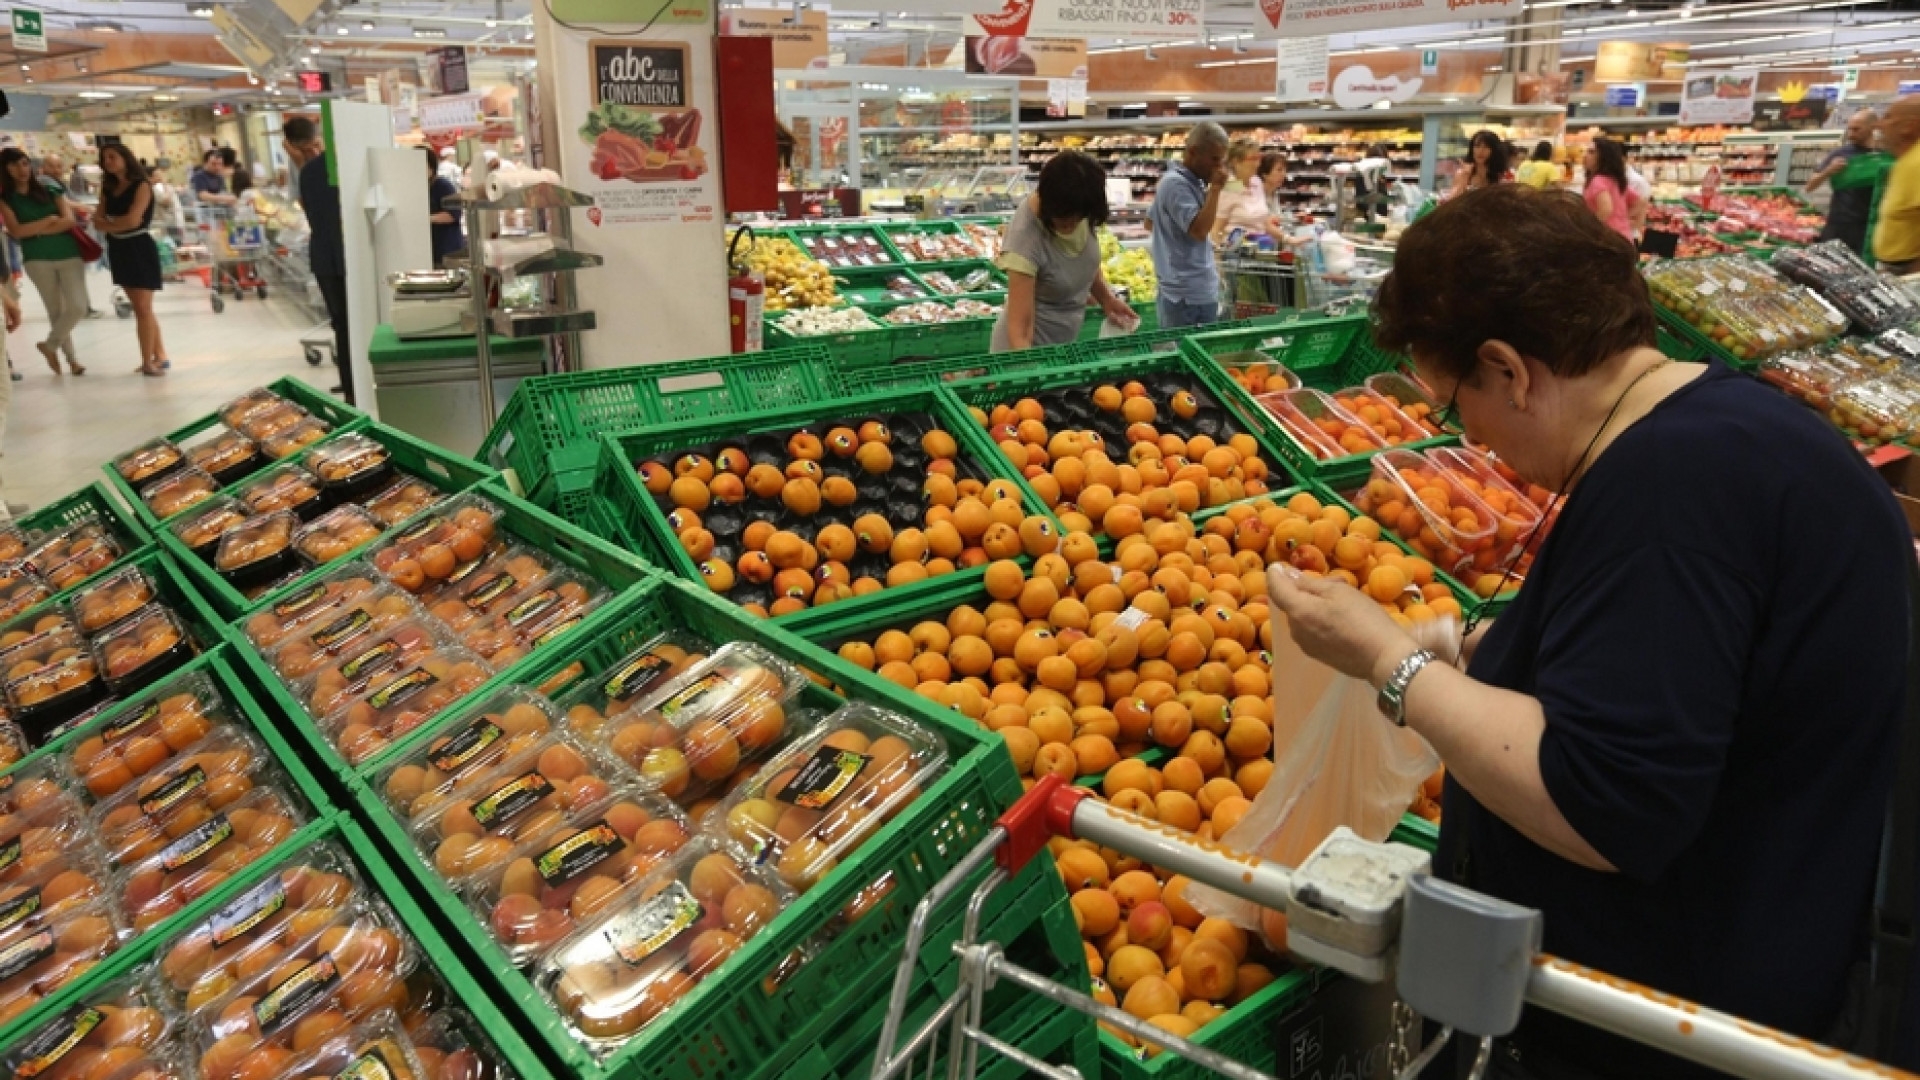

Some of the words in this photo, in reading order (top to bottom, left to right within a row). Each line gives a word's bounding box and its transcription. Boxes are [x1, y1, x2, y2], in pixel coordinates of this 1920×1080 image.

[1058, 8, 1114, 22] RIBASSATI
[1117, 10, 1147, 23] FINO
[1150, 11, 1163, 25] AL
[1168, 11, 1198, 25] 30%
[600, 82, 680, 104] CONVENIENZA
